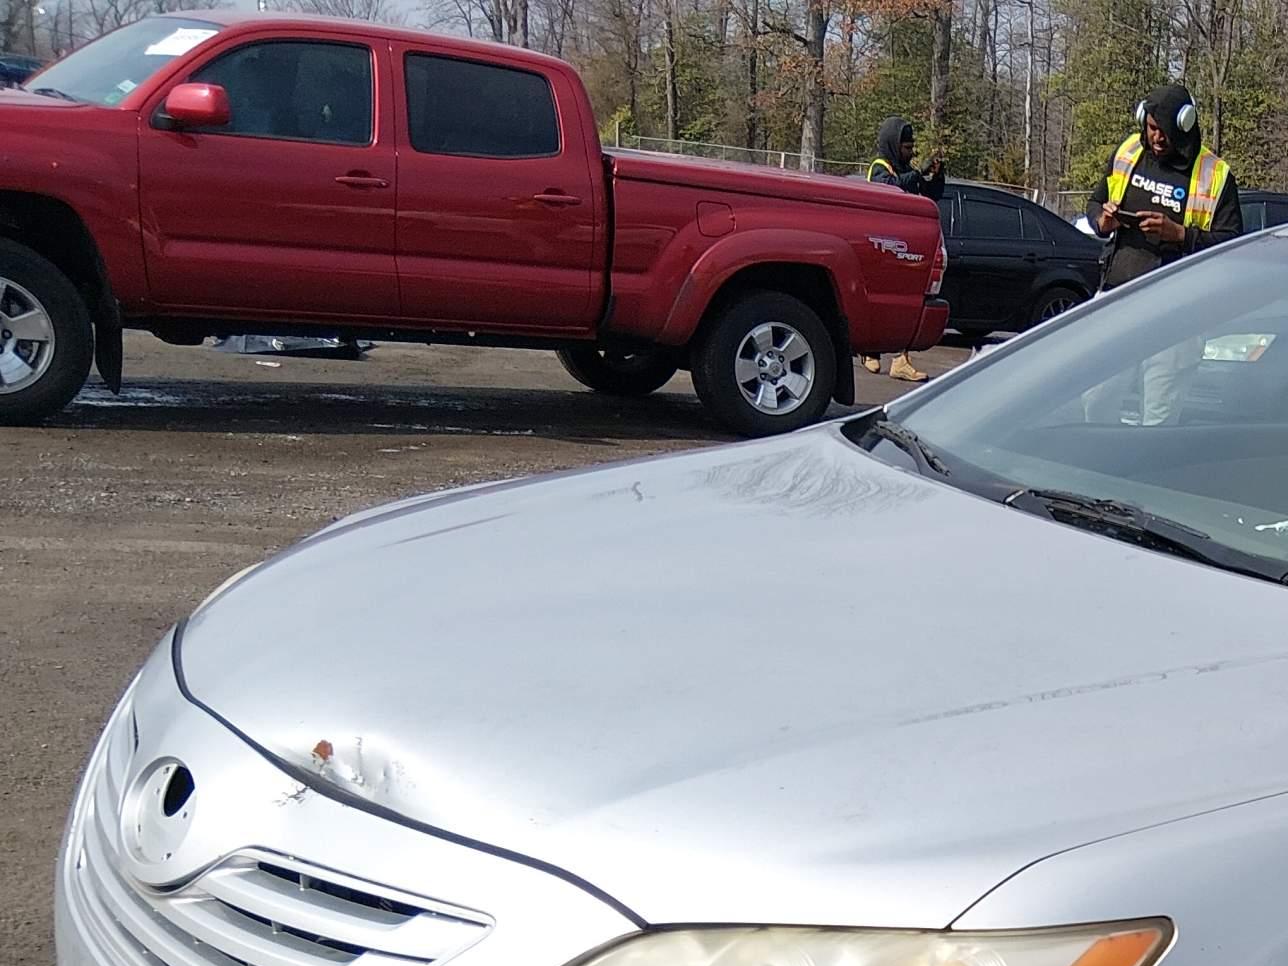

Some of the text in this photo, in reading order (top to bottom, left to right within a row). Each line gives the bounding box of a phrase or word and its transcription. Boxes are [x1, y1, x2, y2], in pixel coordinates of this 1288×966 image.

[1131, 174, 1174, 198] CHASE
[1151, 195, 1160, 204] a
[867, 236, 908, 255] TRD
[896, 252, 924, 262] SPORT
